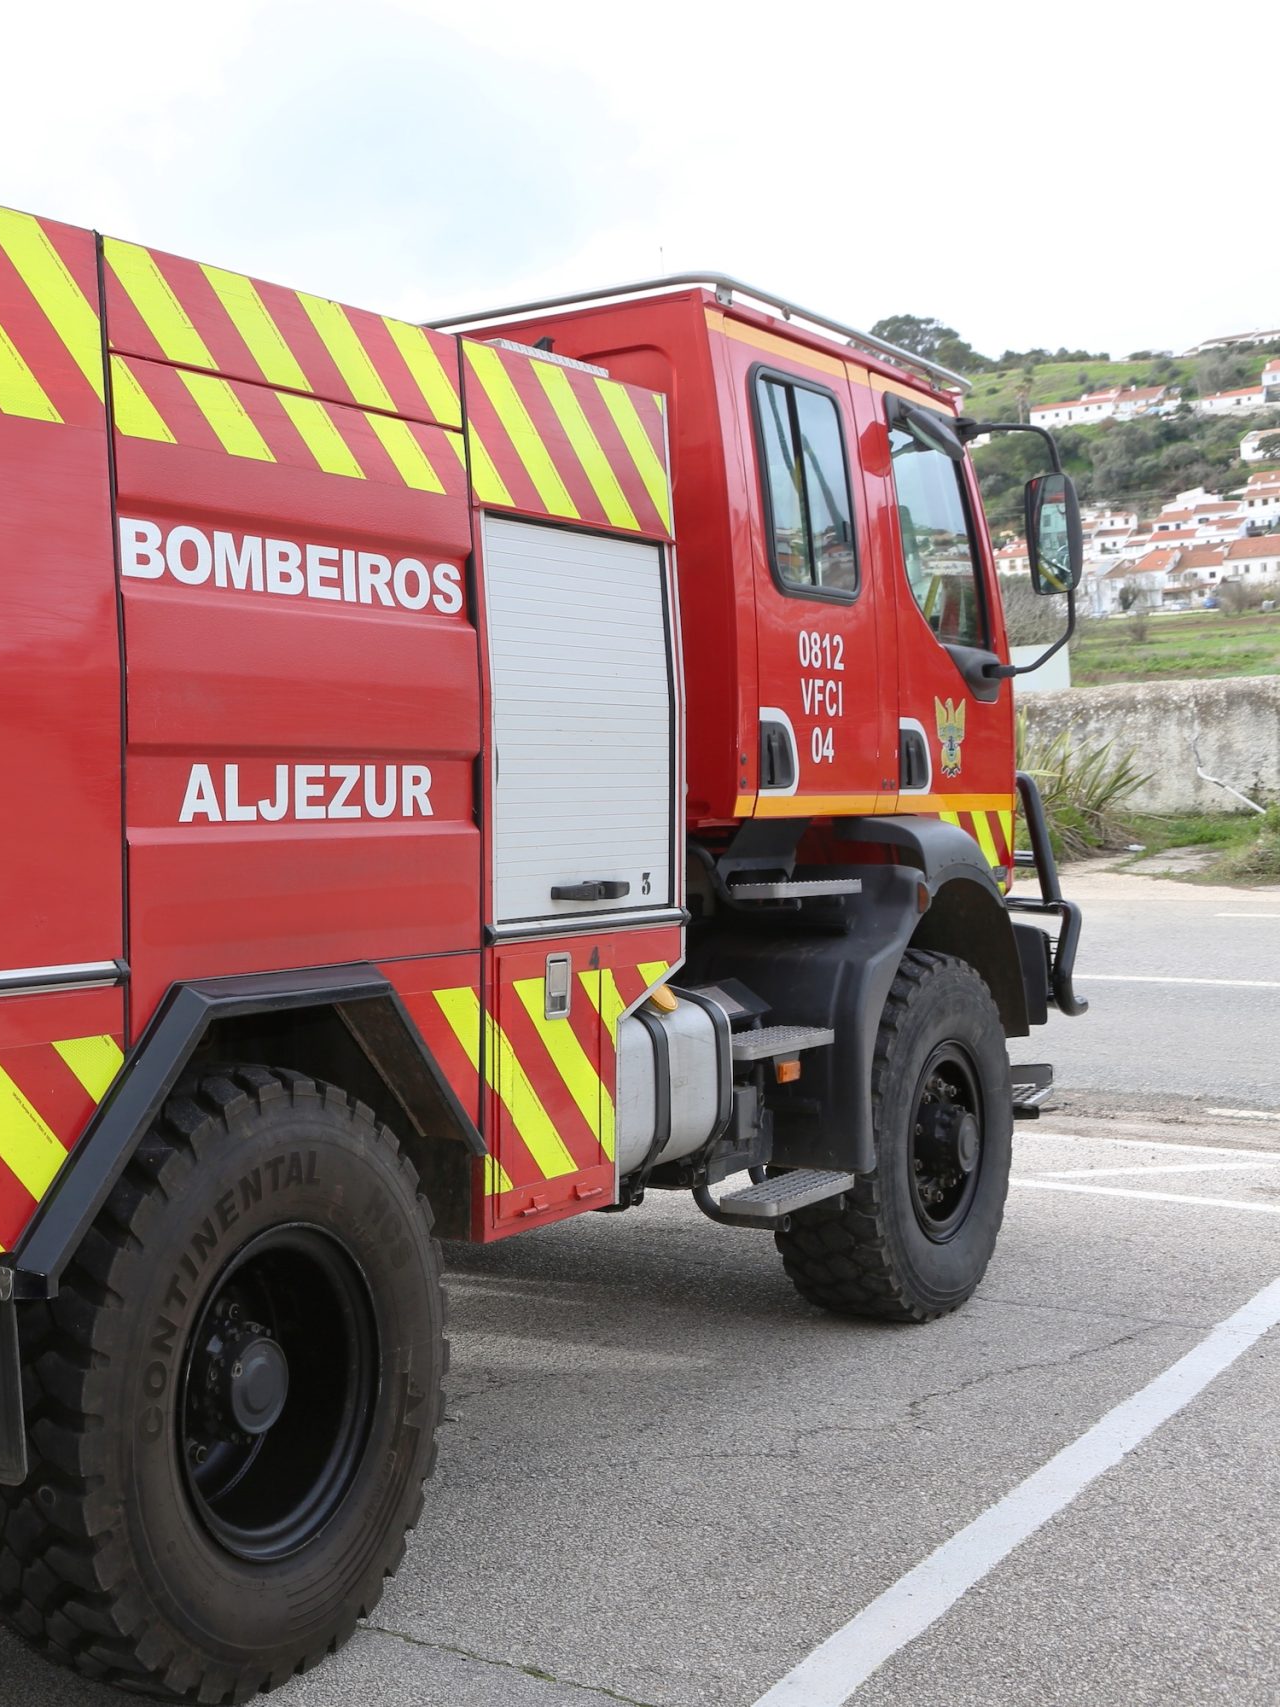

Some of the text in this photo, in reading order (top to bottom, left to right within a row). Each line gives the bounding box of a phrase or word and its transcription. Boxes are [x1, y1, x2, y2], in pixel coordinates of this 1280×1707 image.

[118, 517, 464, 615] BOMBEIROS
[798, 630, 845, 671] 0812
[800, 677, 843, 717] VFCI
[810, 726, 835, 764] 04
[178, 763, 434, 823] ALJEZUR
[641, 871, 651, 896] 3
[138, 1149, 322, 1444] CONTINENTAL
